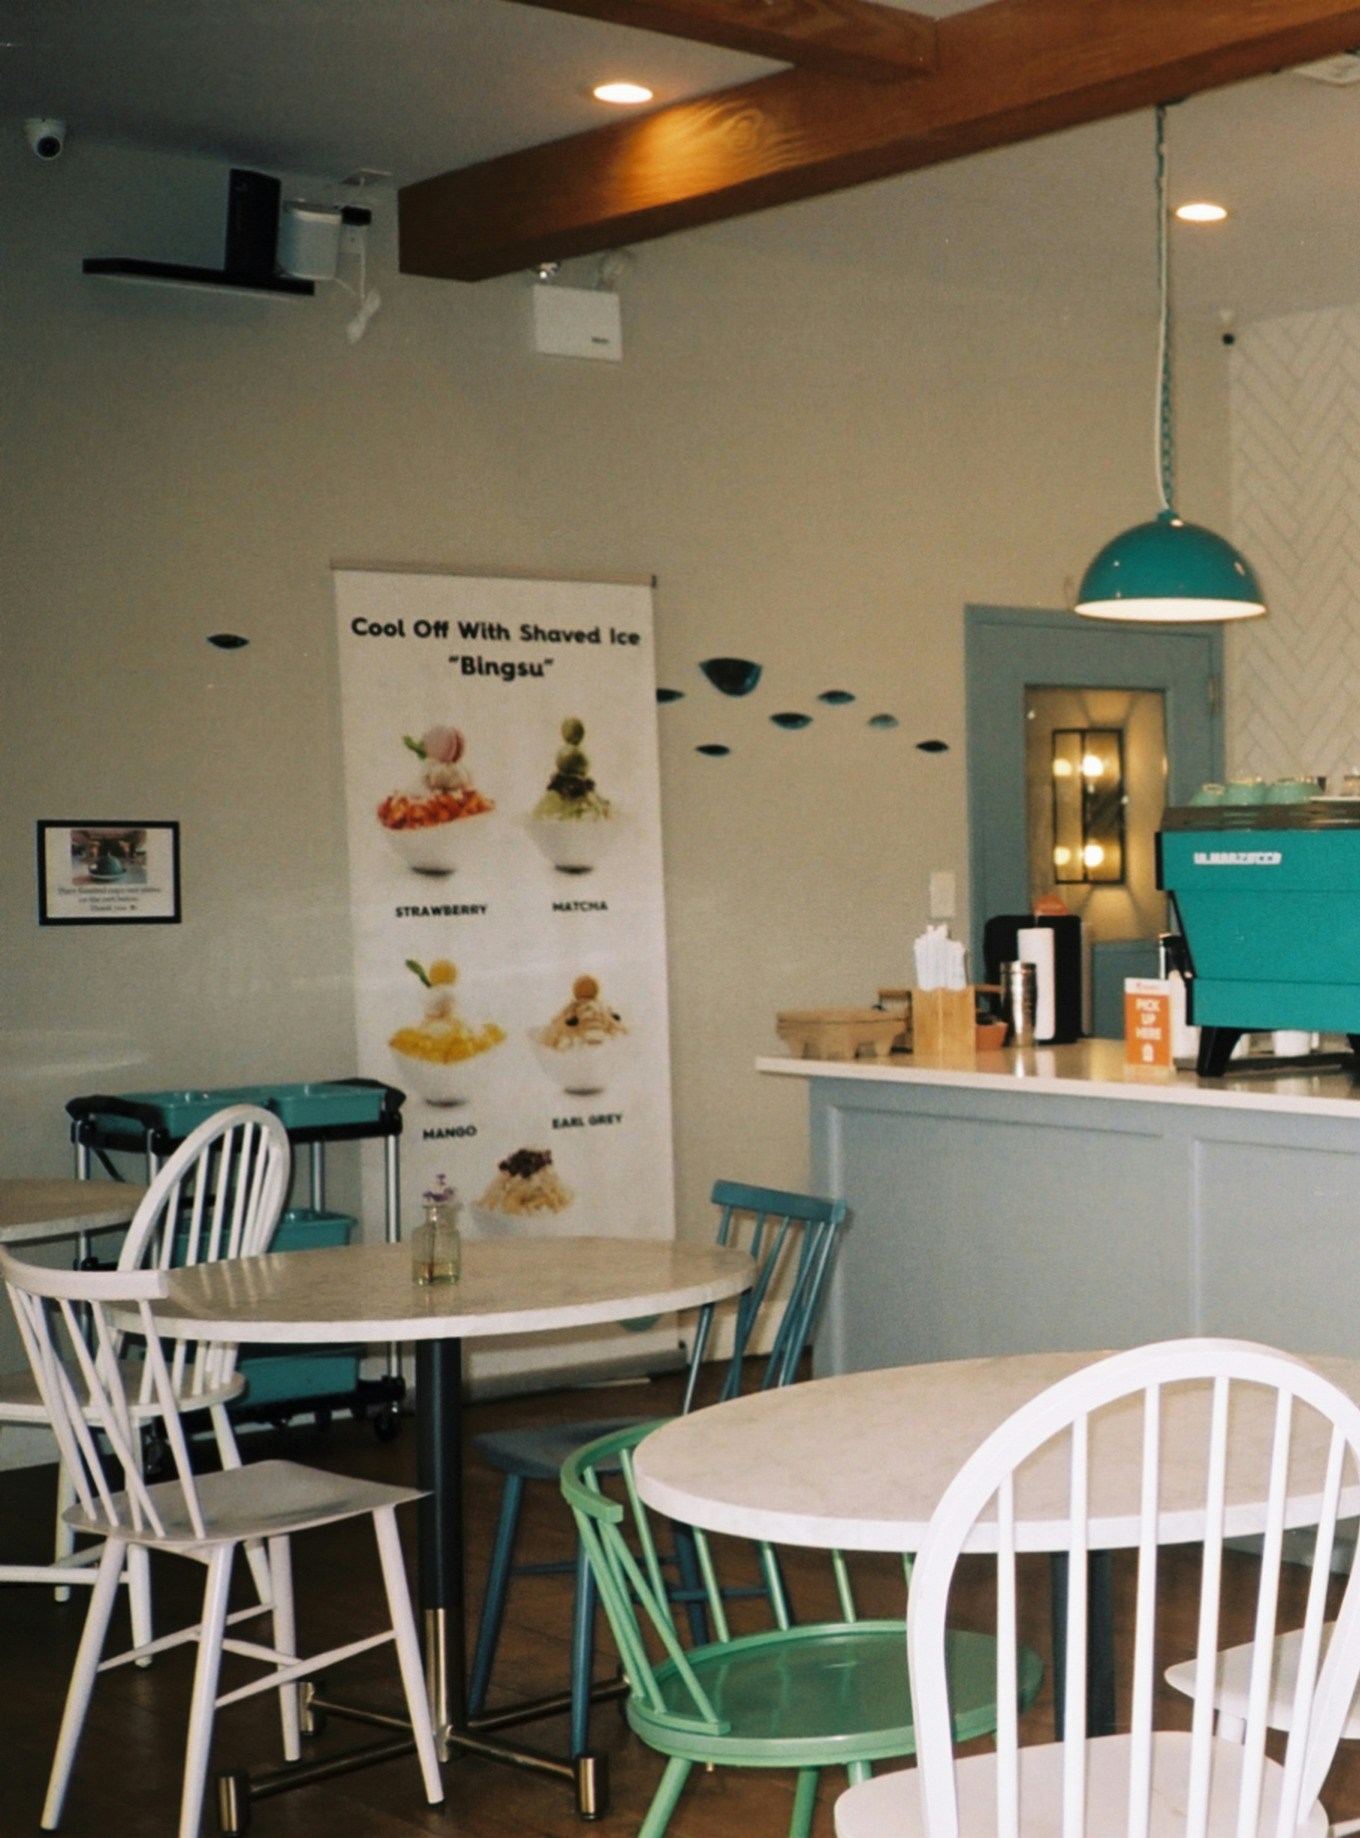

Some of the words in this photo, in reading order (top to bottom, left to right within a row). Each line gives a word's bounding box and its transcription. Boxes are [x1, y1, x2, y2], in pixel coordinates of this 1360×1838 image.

[351, 617, 405, 638] Cool
[413, 619, 449, 639] Off
[458, 620, 511, 641] With
[520, 623, 601, 644] Shaved
[610, 627, 641, 646] Ice
[448, 655, 554, 682] "Bingsu"
[395, 904, 487, 918] STRAWBERRY
[552, 901, 609, 912] MATCHA
[1135, 997, 1161, 1013] PICK
[552, 1117, 585, 1129] EARL
[588, 1113, 623, 1126] GREY
[422, 1125, 478, 1140] MANGO
